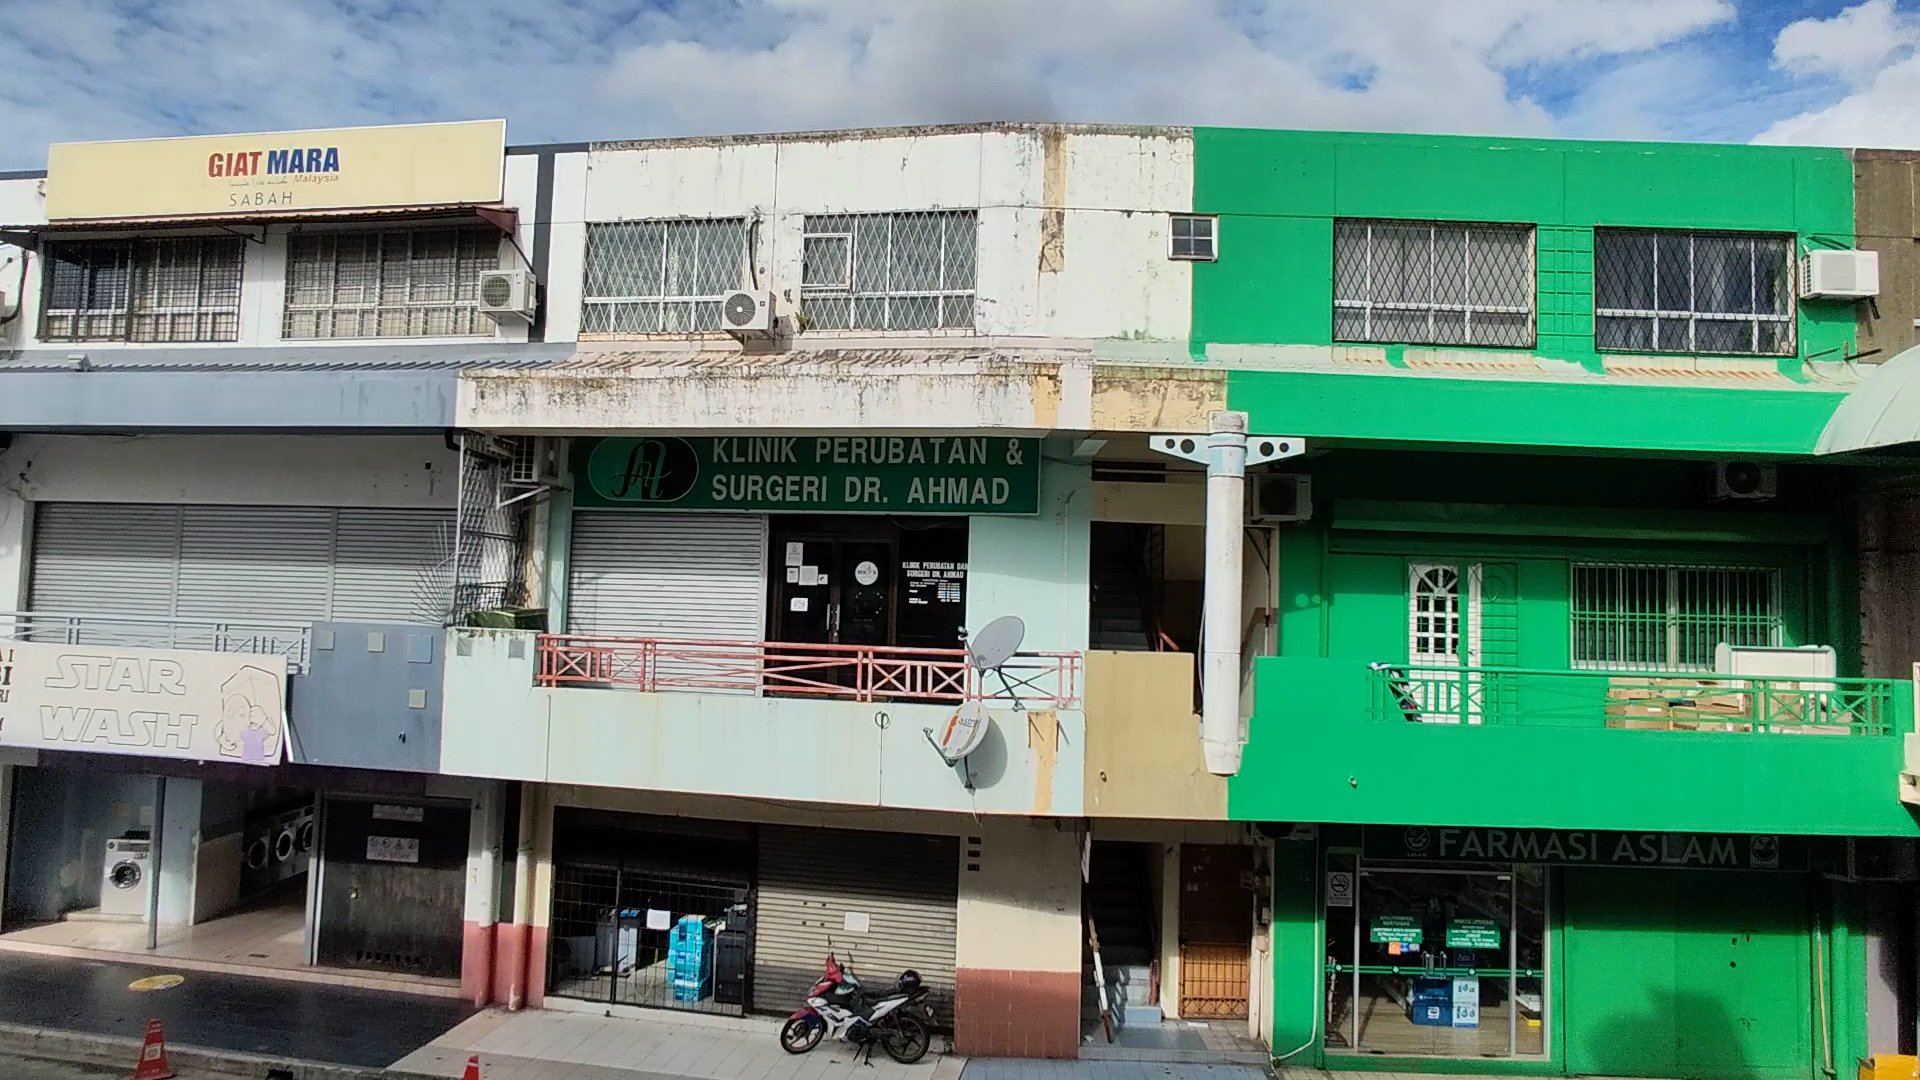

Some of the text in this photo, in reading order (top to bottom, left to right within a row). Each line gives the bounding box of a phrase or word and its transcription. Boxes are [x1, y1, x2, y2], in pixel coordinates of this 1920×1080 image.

[208, 147, 340, 178] GIAT MARA
[293, 174, 339, 185] Malaysia
[229, 191, 293, 207] SABAH
[713, 437, 1024, 466] KLINIK PERUBATAN &
[711, 474, 1010, 505] SURGERI DR. AHMAD
[44, 654, 187, 696] STAR
[39, 705, 199, 749] WASH
[1439, 829, 1738, 865] FARMASI ASLAM
